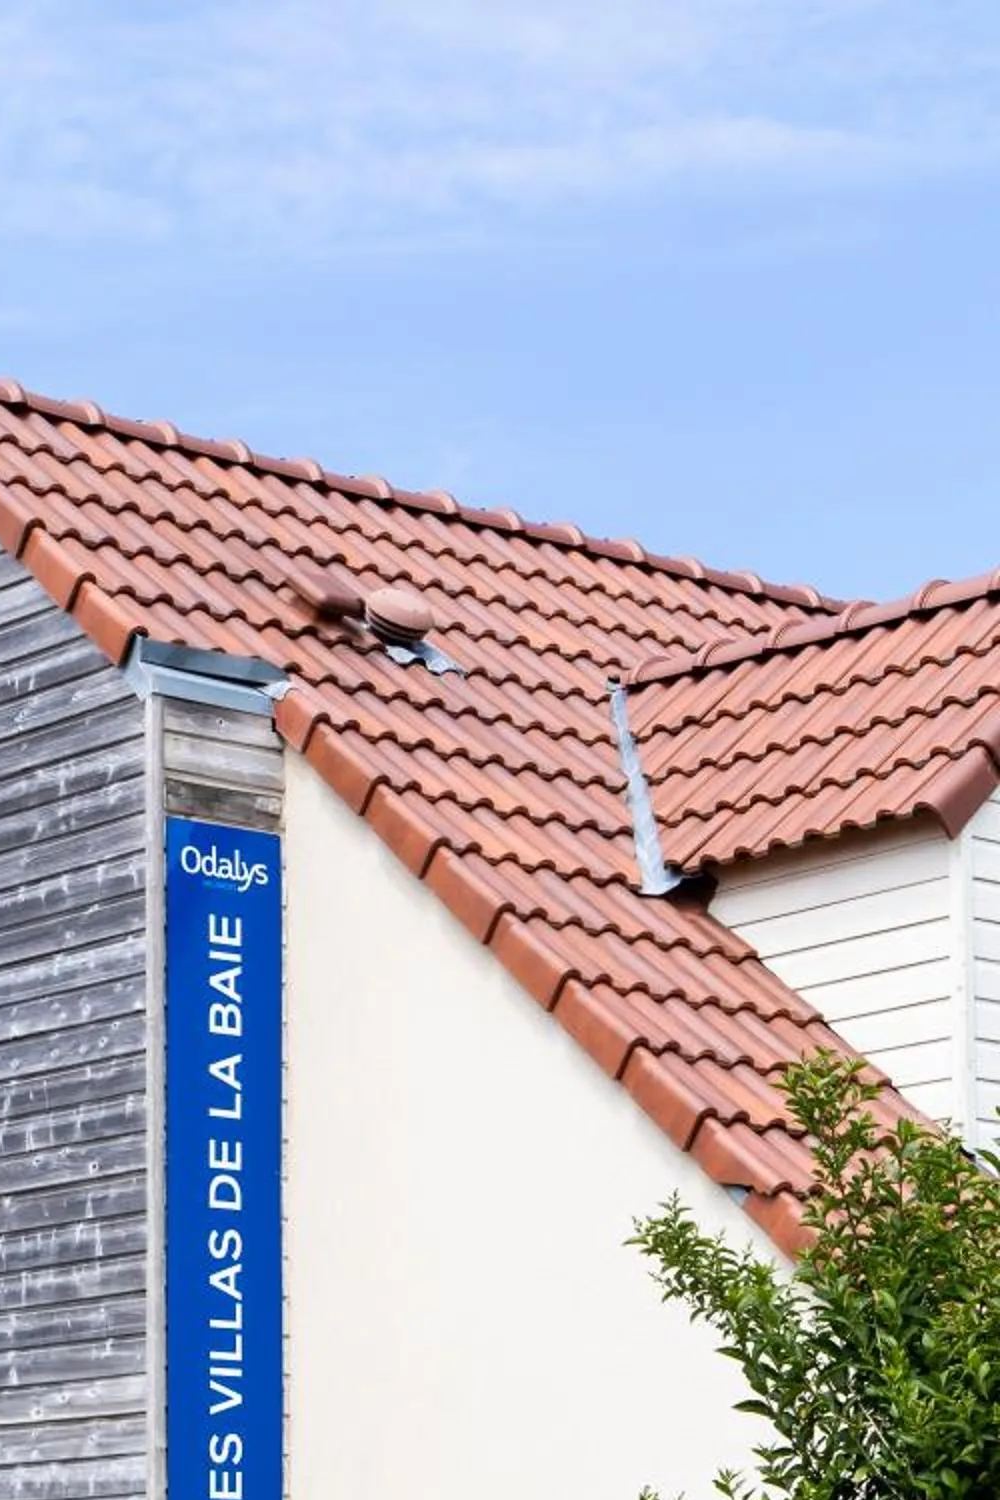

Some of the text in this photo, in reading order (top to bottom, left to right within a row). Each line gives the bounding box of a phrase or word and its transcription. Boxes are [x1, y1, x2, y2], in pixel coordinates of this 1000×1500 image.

[181, 846, 268, 891] Odalys
[208, 913, 242, 1037] BAIE
[208, 1054, 242, 1120] LA
[208, 1139, 243, 1211] DE
[209, 1229, 243, 1415] VILLAS
